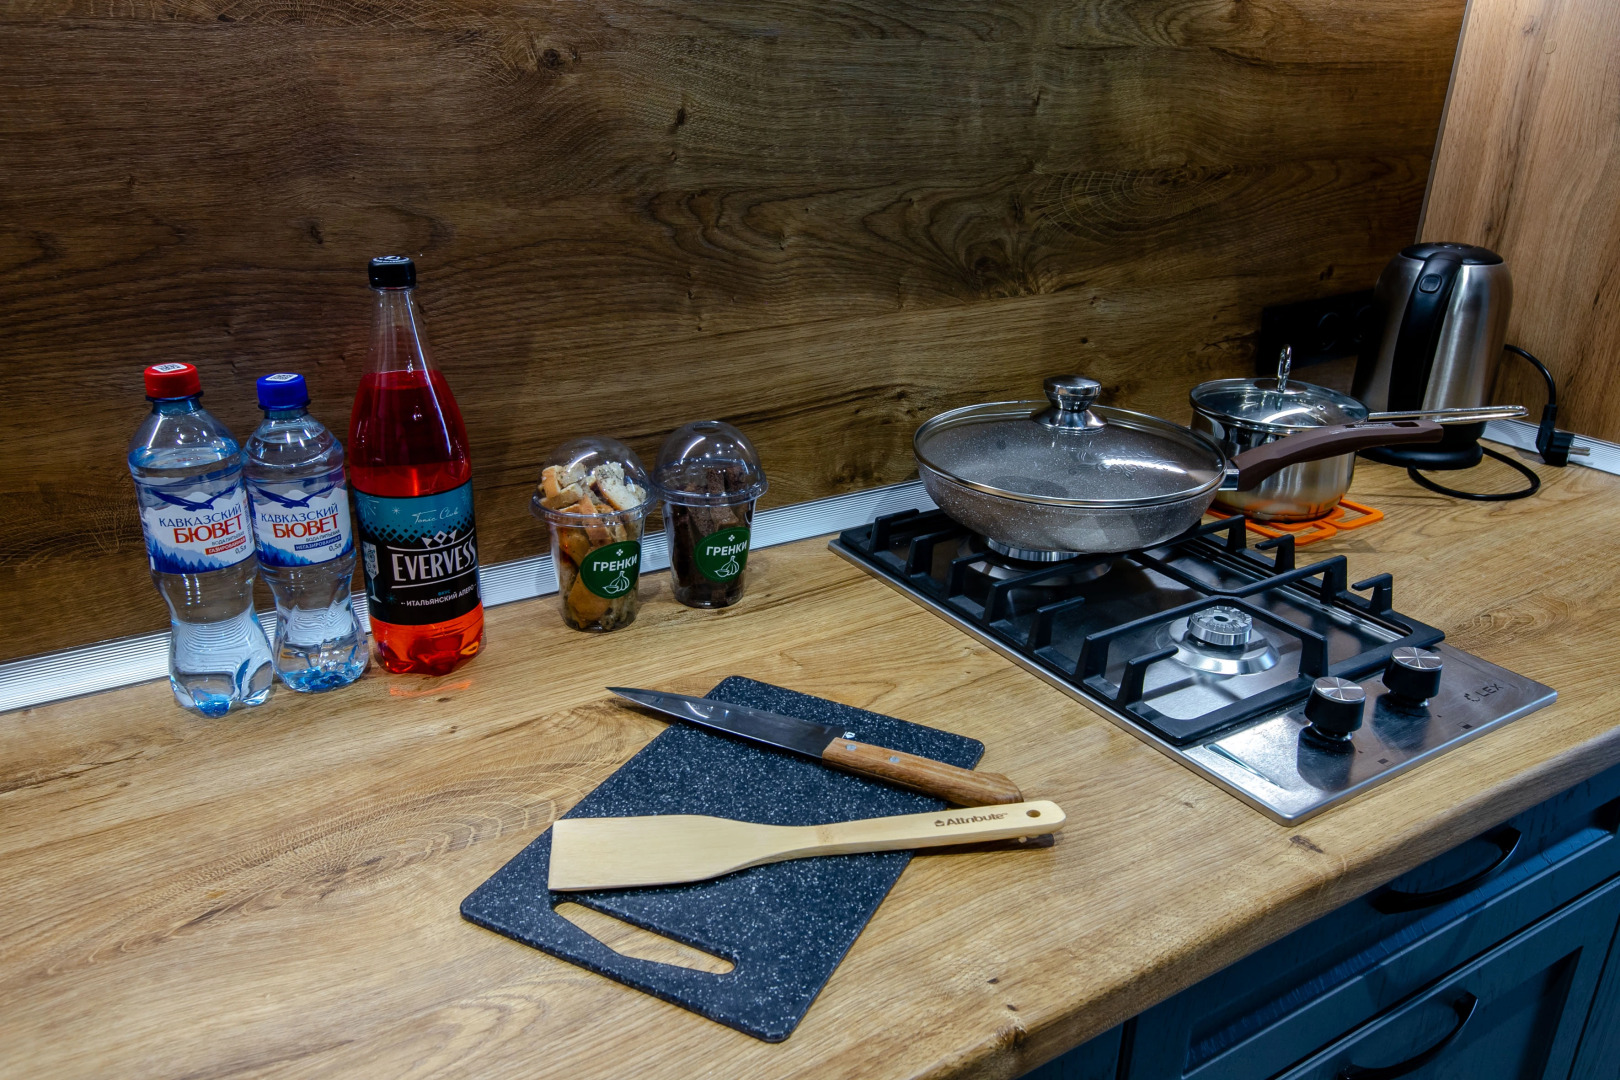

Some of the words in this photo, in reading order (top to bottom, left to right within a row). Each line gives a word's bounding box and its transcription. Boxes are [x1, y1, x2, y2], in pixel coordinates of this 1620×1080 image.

[159, 503, 242, 527] КАВКАЗСКИЙ
[261, 503, 339, 523] КАВКАЗСКИЙ
[412, 510, 437, 524] Tonic
[440, 507, 459, 520] Club
[173, 514, 242, 543] БЮВЕТ
[272, 513, 339, 538] БЮВЕТ
[296, 535, 341, 550] НЕГАЗИРОВАННАЯ
[706, 539, 747, 557] ГРЕНКИ
[391, 536, 476, 582] EVERVESS
[593, 553, 638, 572] ГРЕНКИ
[406, 592, 458, 607] ИТАЛЬЯНСКИЙ
